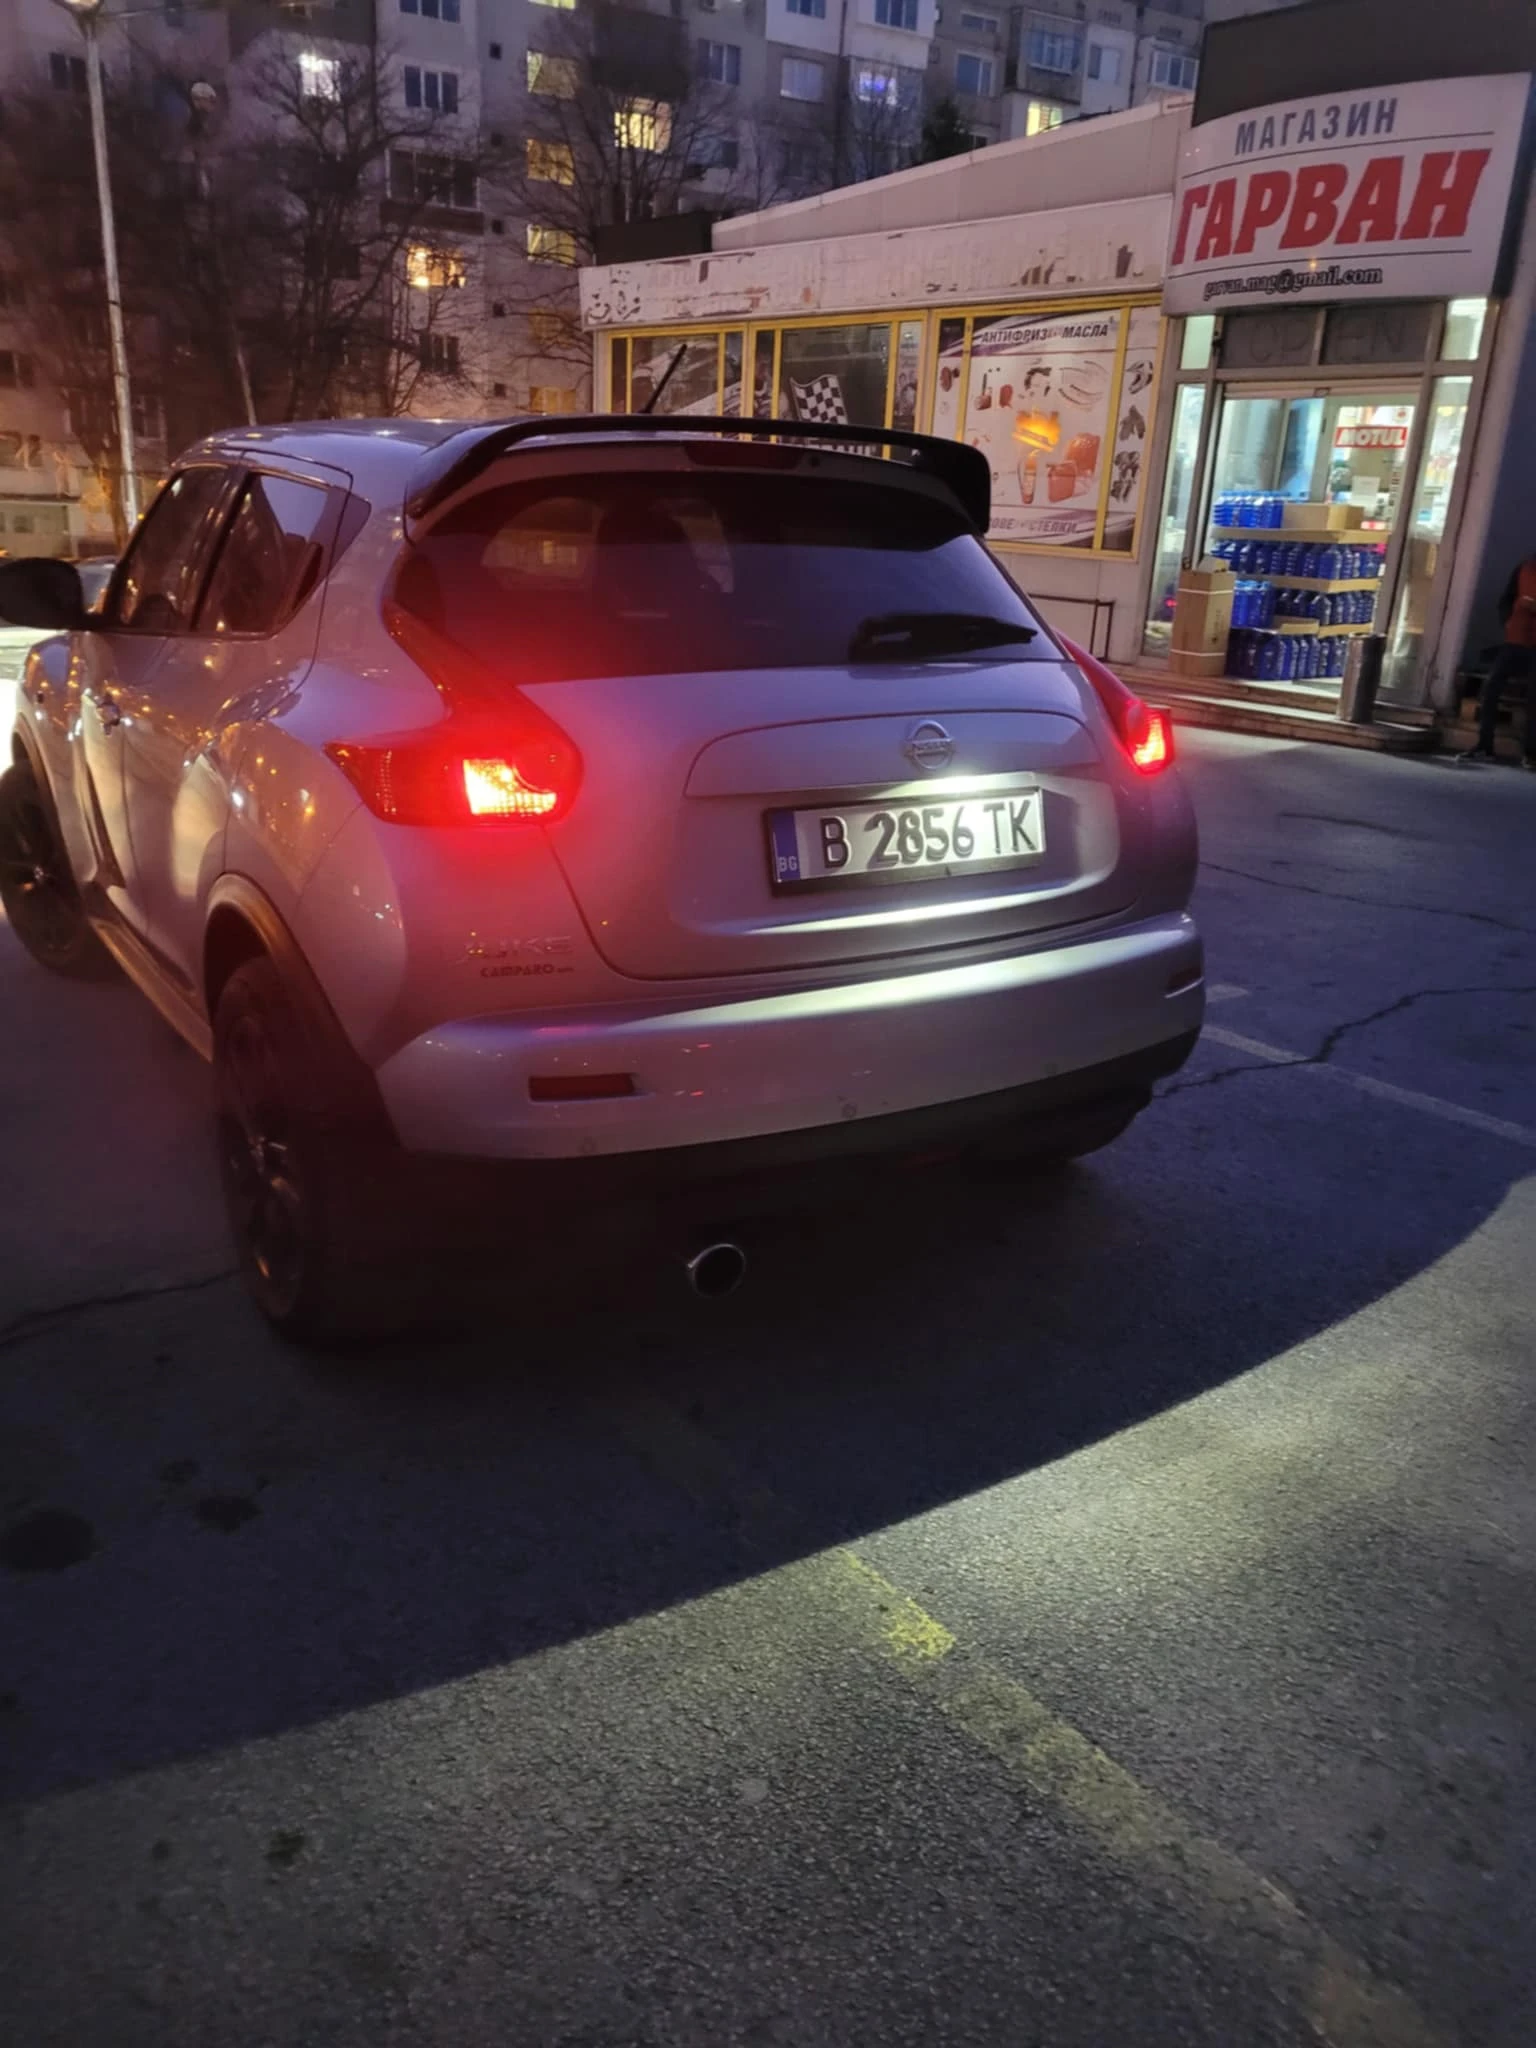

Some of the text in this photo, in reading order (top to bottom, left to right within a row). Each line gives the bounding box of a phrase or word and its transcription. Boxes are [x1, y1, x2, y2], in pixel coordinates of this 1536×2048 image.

[1234, 98, 1397, 155] МАГАЗИН
[1171, 147, 1493, 266] ГАРВАН
[981, 324, 1109, 343] АНТИФРИЗ МАСЛА
[1337, 427, 1404, 446] MOTUL
[820, 799, 1038, 871] B 2856 TK
[778, 856, 798, 872] BG
